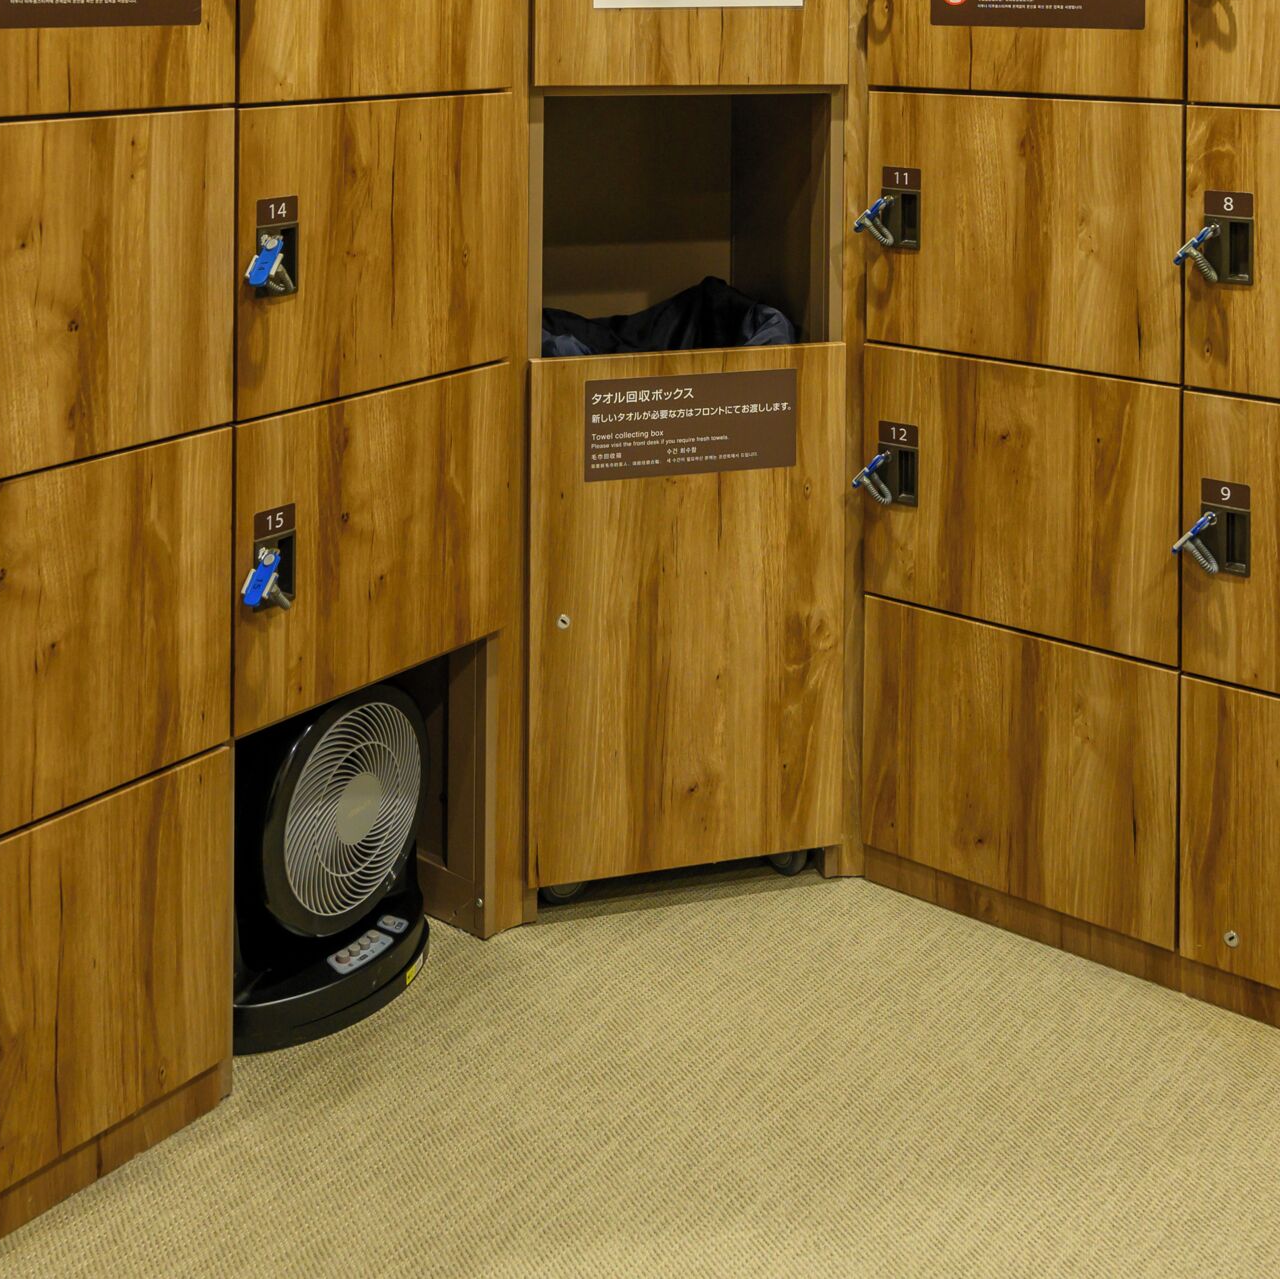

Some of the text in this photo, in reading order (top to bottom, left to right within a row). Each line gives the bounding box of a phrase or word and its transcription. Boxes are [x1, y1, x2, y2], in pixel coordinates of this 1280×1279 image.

[894, 171, 909, 186] 11
[269, 202, 287, 219] 14
[1223, 196, 1234, 212] 8
[591, 387, 694, 405] タオル回収ボックス
[591, 402, 791, 423] 新しいタオルが必要な方はフロントにてお渡しします。
[591, 429, 664, 441] Towel collecting box
[890, 426, 908, 442] 12
[1220, 486, 1231, 501] 9
[266, 511, 284, 531] 15
